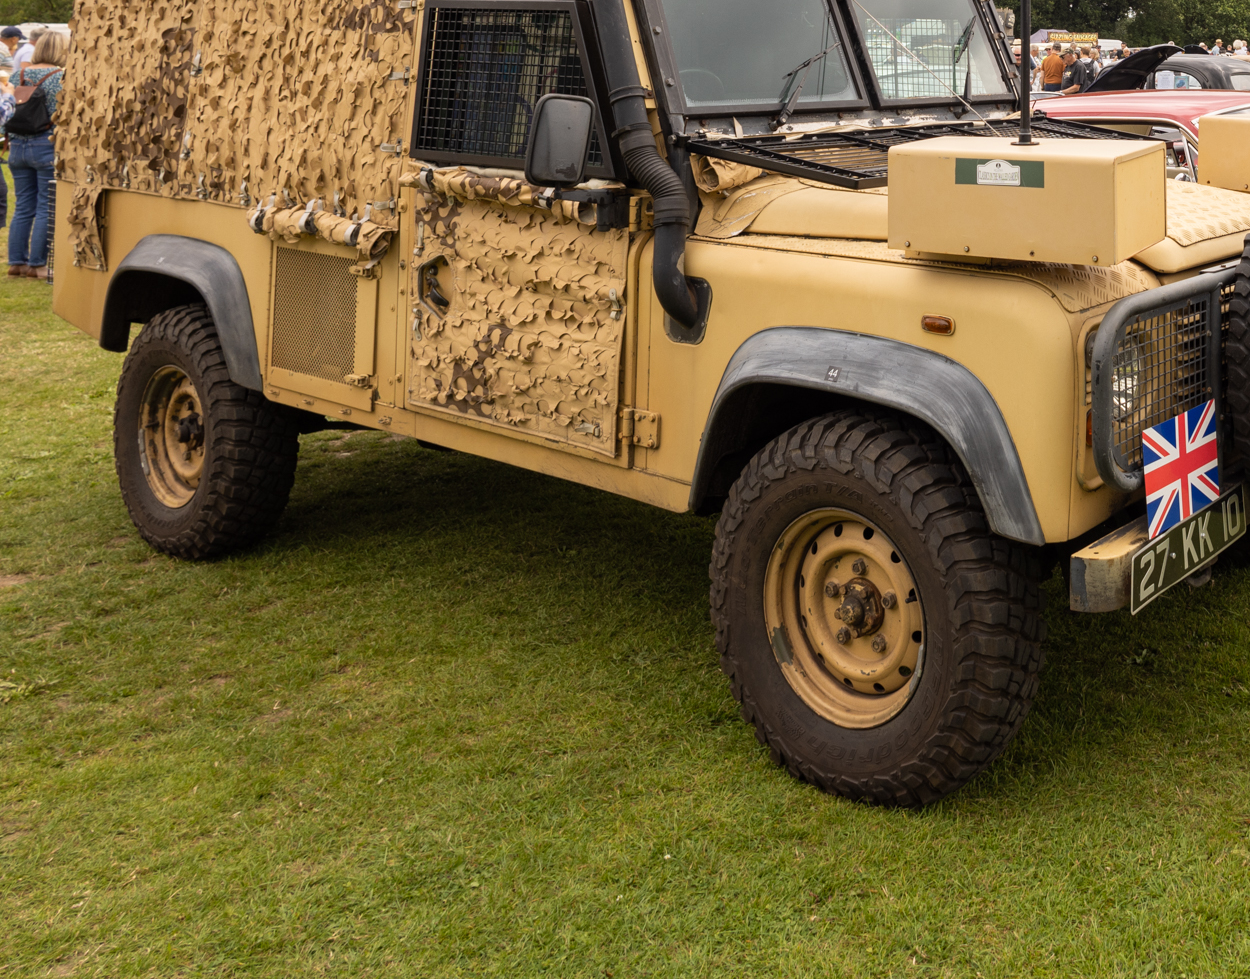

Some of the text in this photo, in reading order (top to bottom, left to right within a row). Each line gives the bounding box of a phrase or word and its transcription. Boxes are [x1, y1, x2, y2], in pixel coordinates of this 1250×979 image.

[828, 368, 839, 378] 44
[1139, 493, 1241, 602] 27 KK 10
